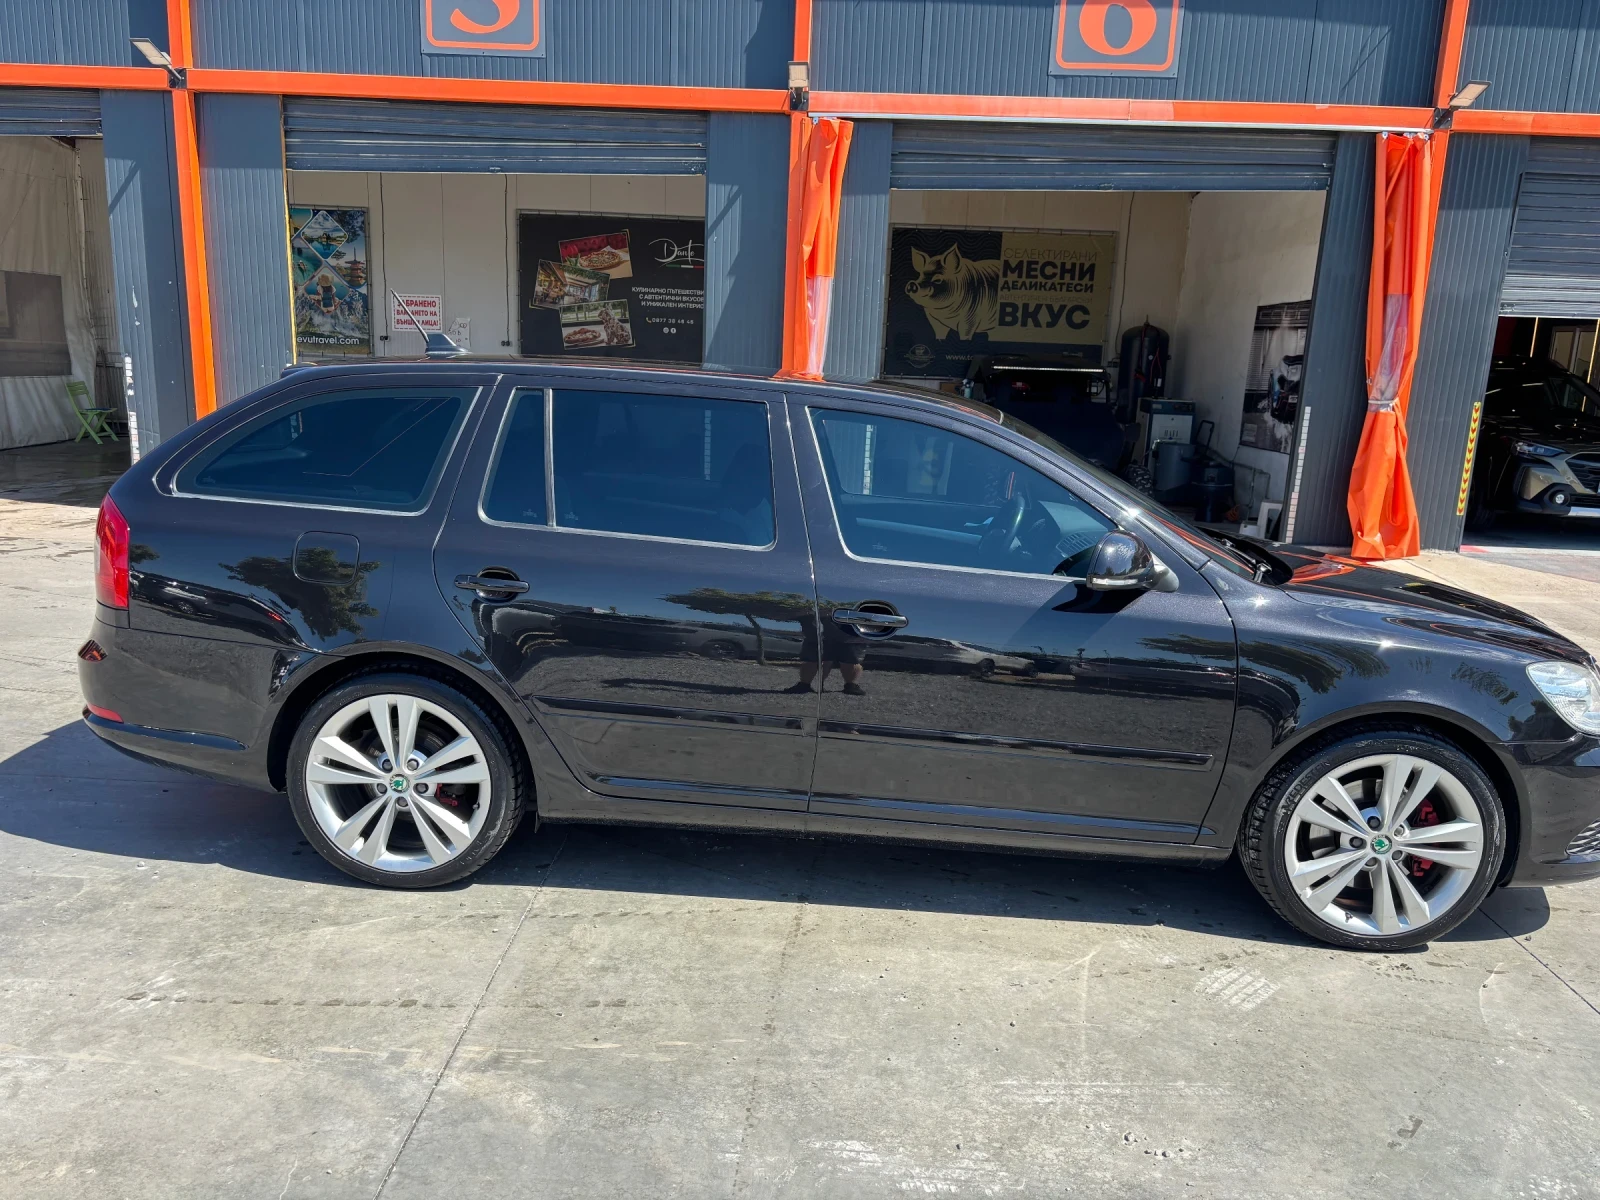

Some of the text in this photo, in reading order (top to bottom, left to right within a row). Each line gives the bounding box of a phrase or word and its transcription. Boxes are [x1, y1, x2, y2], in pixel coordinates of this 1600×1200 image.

[648, 238, 704, 264] Dante
[1003, 248, 1098, 261] СЕЛЕКТИРАНИ
[1002, 259, 1096, 281] МЕСНИ
[631, 286, 666, 294] КУЛИНАРНО
[1000, 280, 1094, 293] ДЕЛИКАТЕСИ
[397, 299, 437, 308] ЗБРАНЕНО
[998, 302, 1091, 330] ВКУС
[297, 336, 360, 345] evutravel.com
